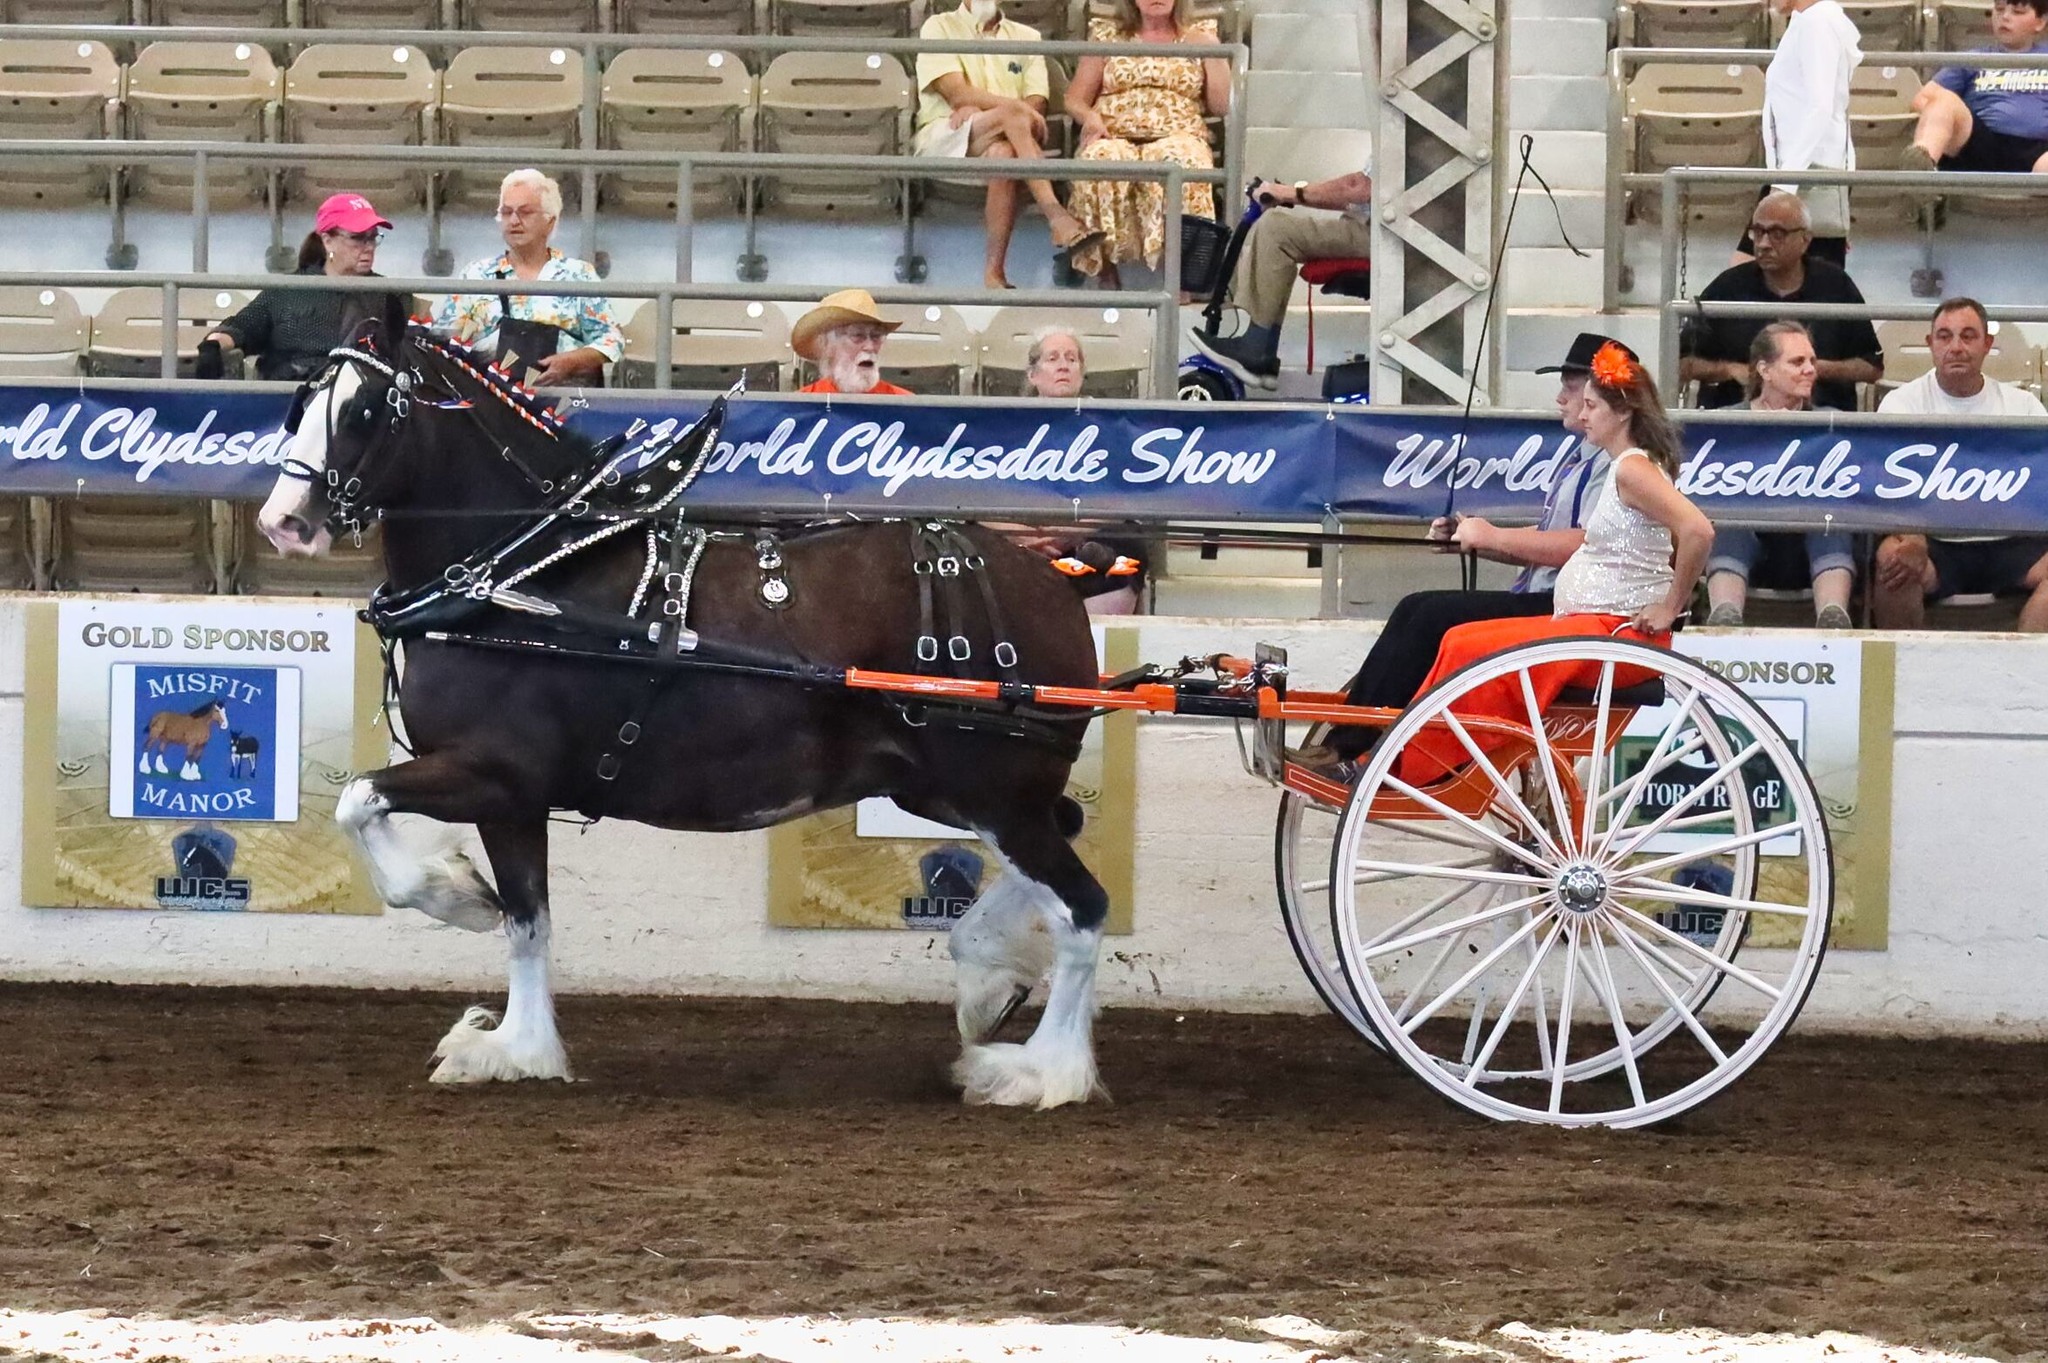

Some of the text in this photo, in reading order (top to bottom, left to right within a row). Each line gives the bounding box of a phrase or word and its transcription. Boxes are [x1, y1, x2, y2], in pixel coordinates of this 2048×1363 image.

[80, 407, 300, 482] Clydesda
[827, 421, 1109, 497] Clydesdale
[1122, 426, 1277, 484] Show
[1383, 433, 2031, 502] World desdale Show
[82, 622, 331, 653] GOLD SPONSOR
[1690, 656, 1836, 685] PONSOR
[147, 672, 262, 705] MISFIT
[141, 783, 256, 813] MANOR
[1712, 779, 1781, 809] RGE
[156, 876, 250, 902] WCS
[903, 896, 979, 920] WC
